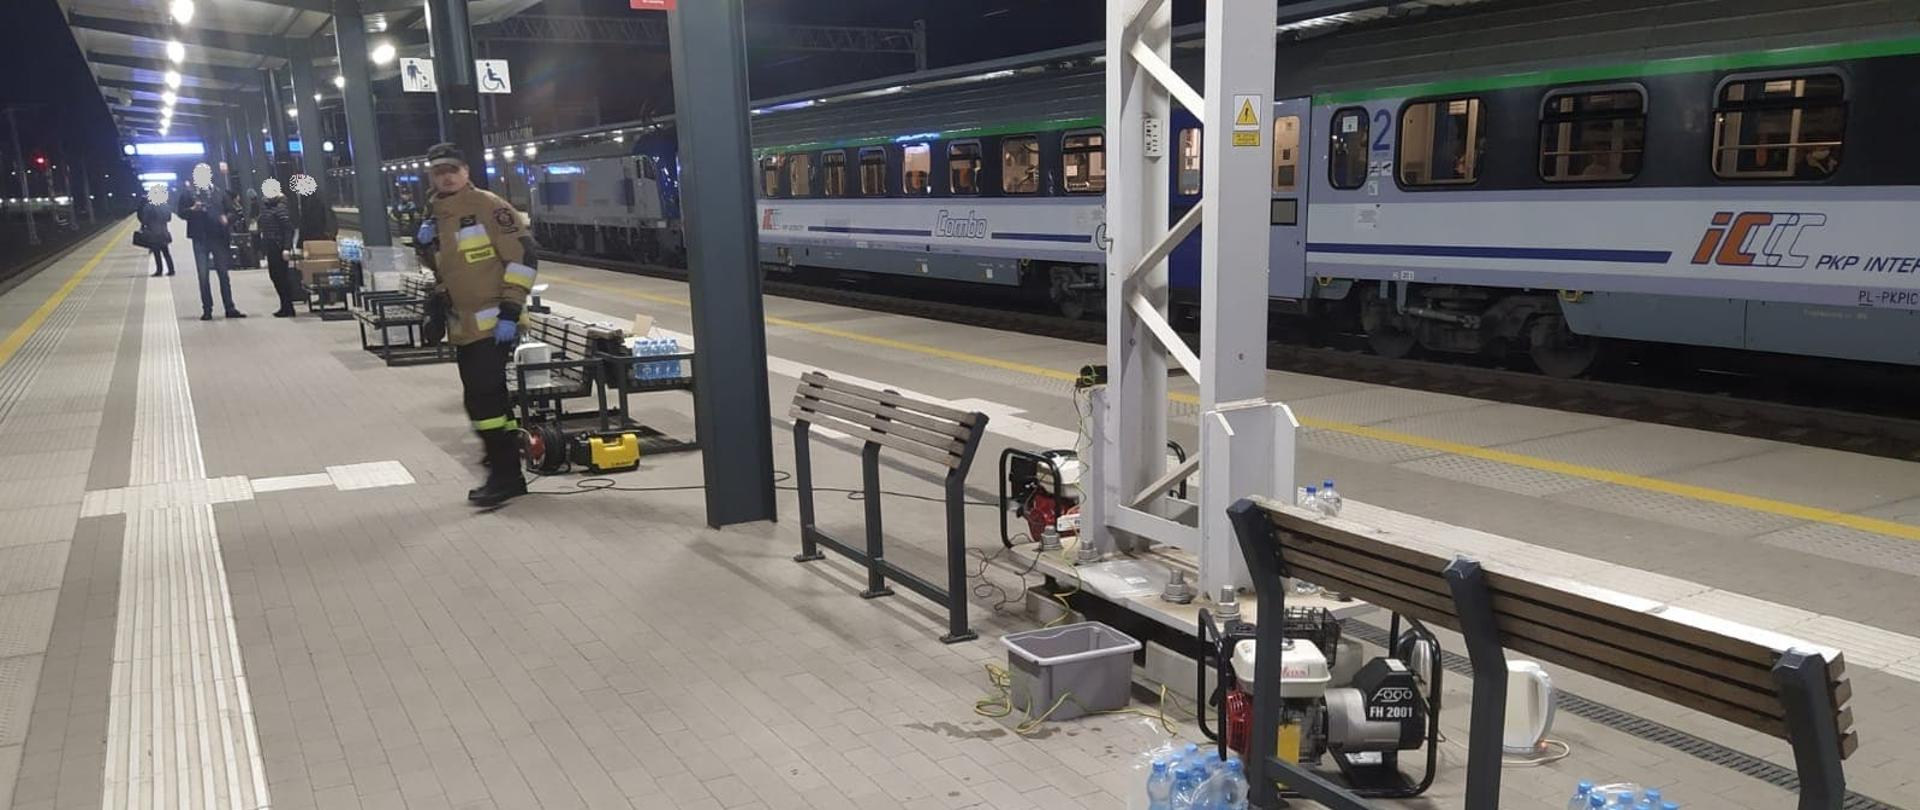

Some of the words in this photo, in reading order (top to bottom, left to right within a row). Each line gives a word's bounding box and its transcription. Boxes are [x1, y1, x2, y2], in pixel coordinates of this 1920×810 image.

[1372, 108, 1392, 151] 2
[936, 209, 988, 239] Combo
[1815, 254, 1859, 270] PKP
[1369, 706, 1384, 718] FH
[1387, 706, 1413, 718] 2001
